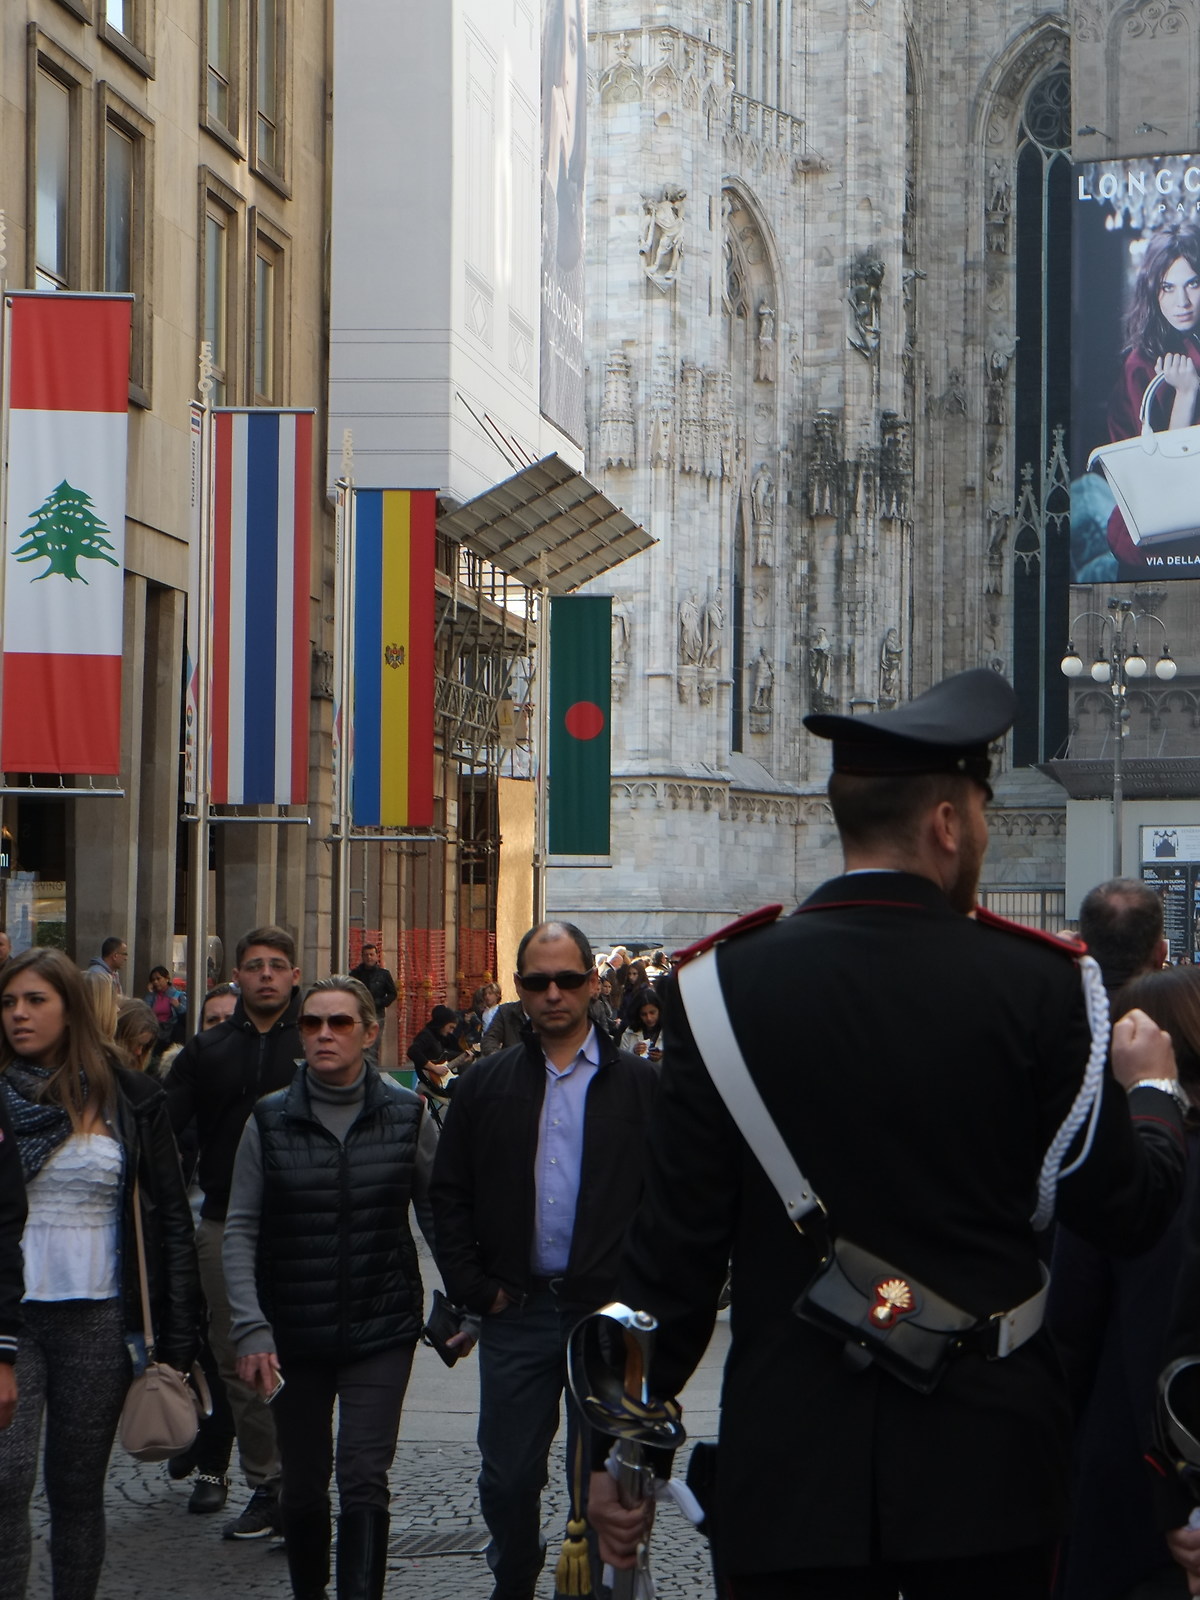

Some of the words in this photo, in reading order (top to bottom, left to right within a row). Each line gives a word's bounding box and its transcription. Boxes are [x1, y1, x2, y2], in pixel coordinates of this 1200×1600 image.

[197, 341, 214, 392] EXPO
[1146, 555, 1164, 565] VIA
[1134, 781, 1182, 790] Duomo
